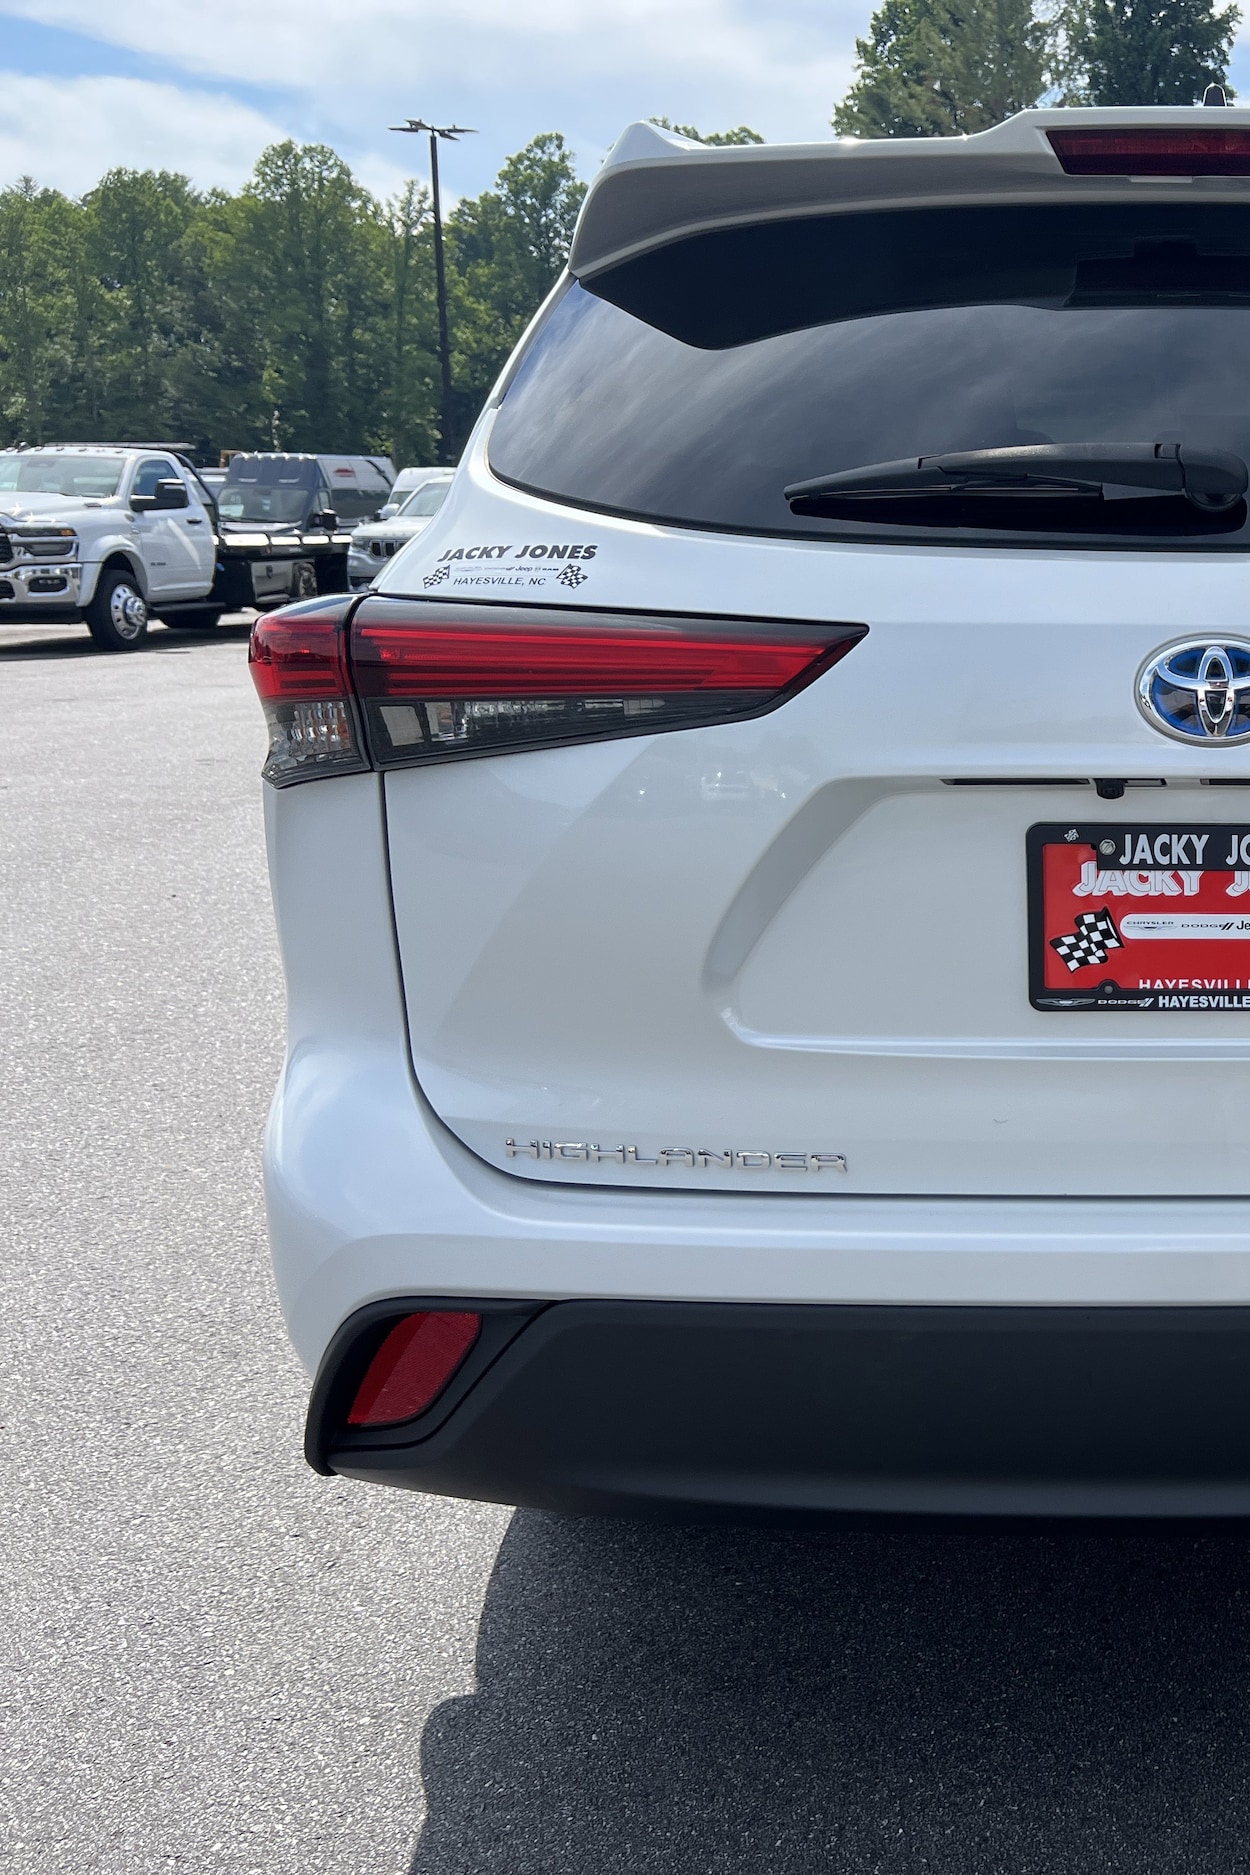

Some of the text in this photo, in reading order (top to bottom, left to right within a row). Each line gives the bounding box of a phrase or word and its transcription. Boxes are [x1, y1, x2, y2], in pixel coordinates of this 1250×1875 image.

[437, 544, 598, 562] JACKY JONES
[453, 576, 546, 586] HAYESVILLE, NC
[515, 565, 533, 573] Jeep
[1119, 834, 1209, 866] JACKY
[1072, 860, 1205, 897] JACKY
[505, 1137, 848, 1173] HIGHLANDER
